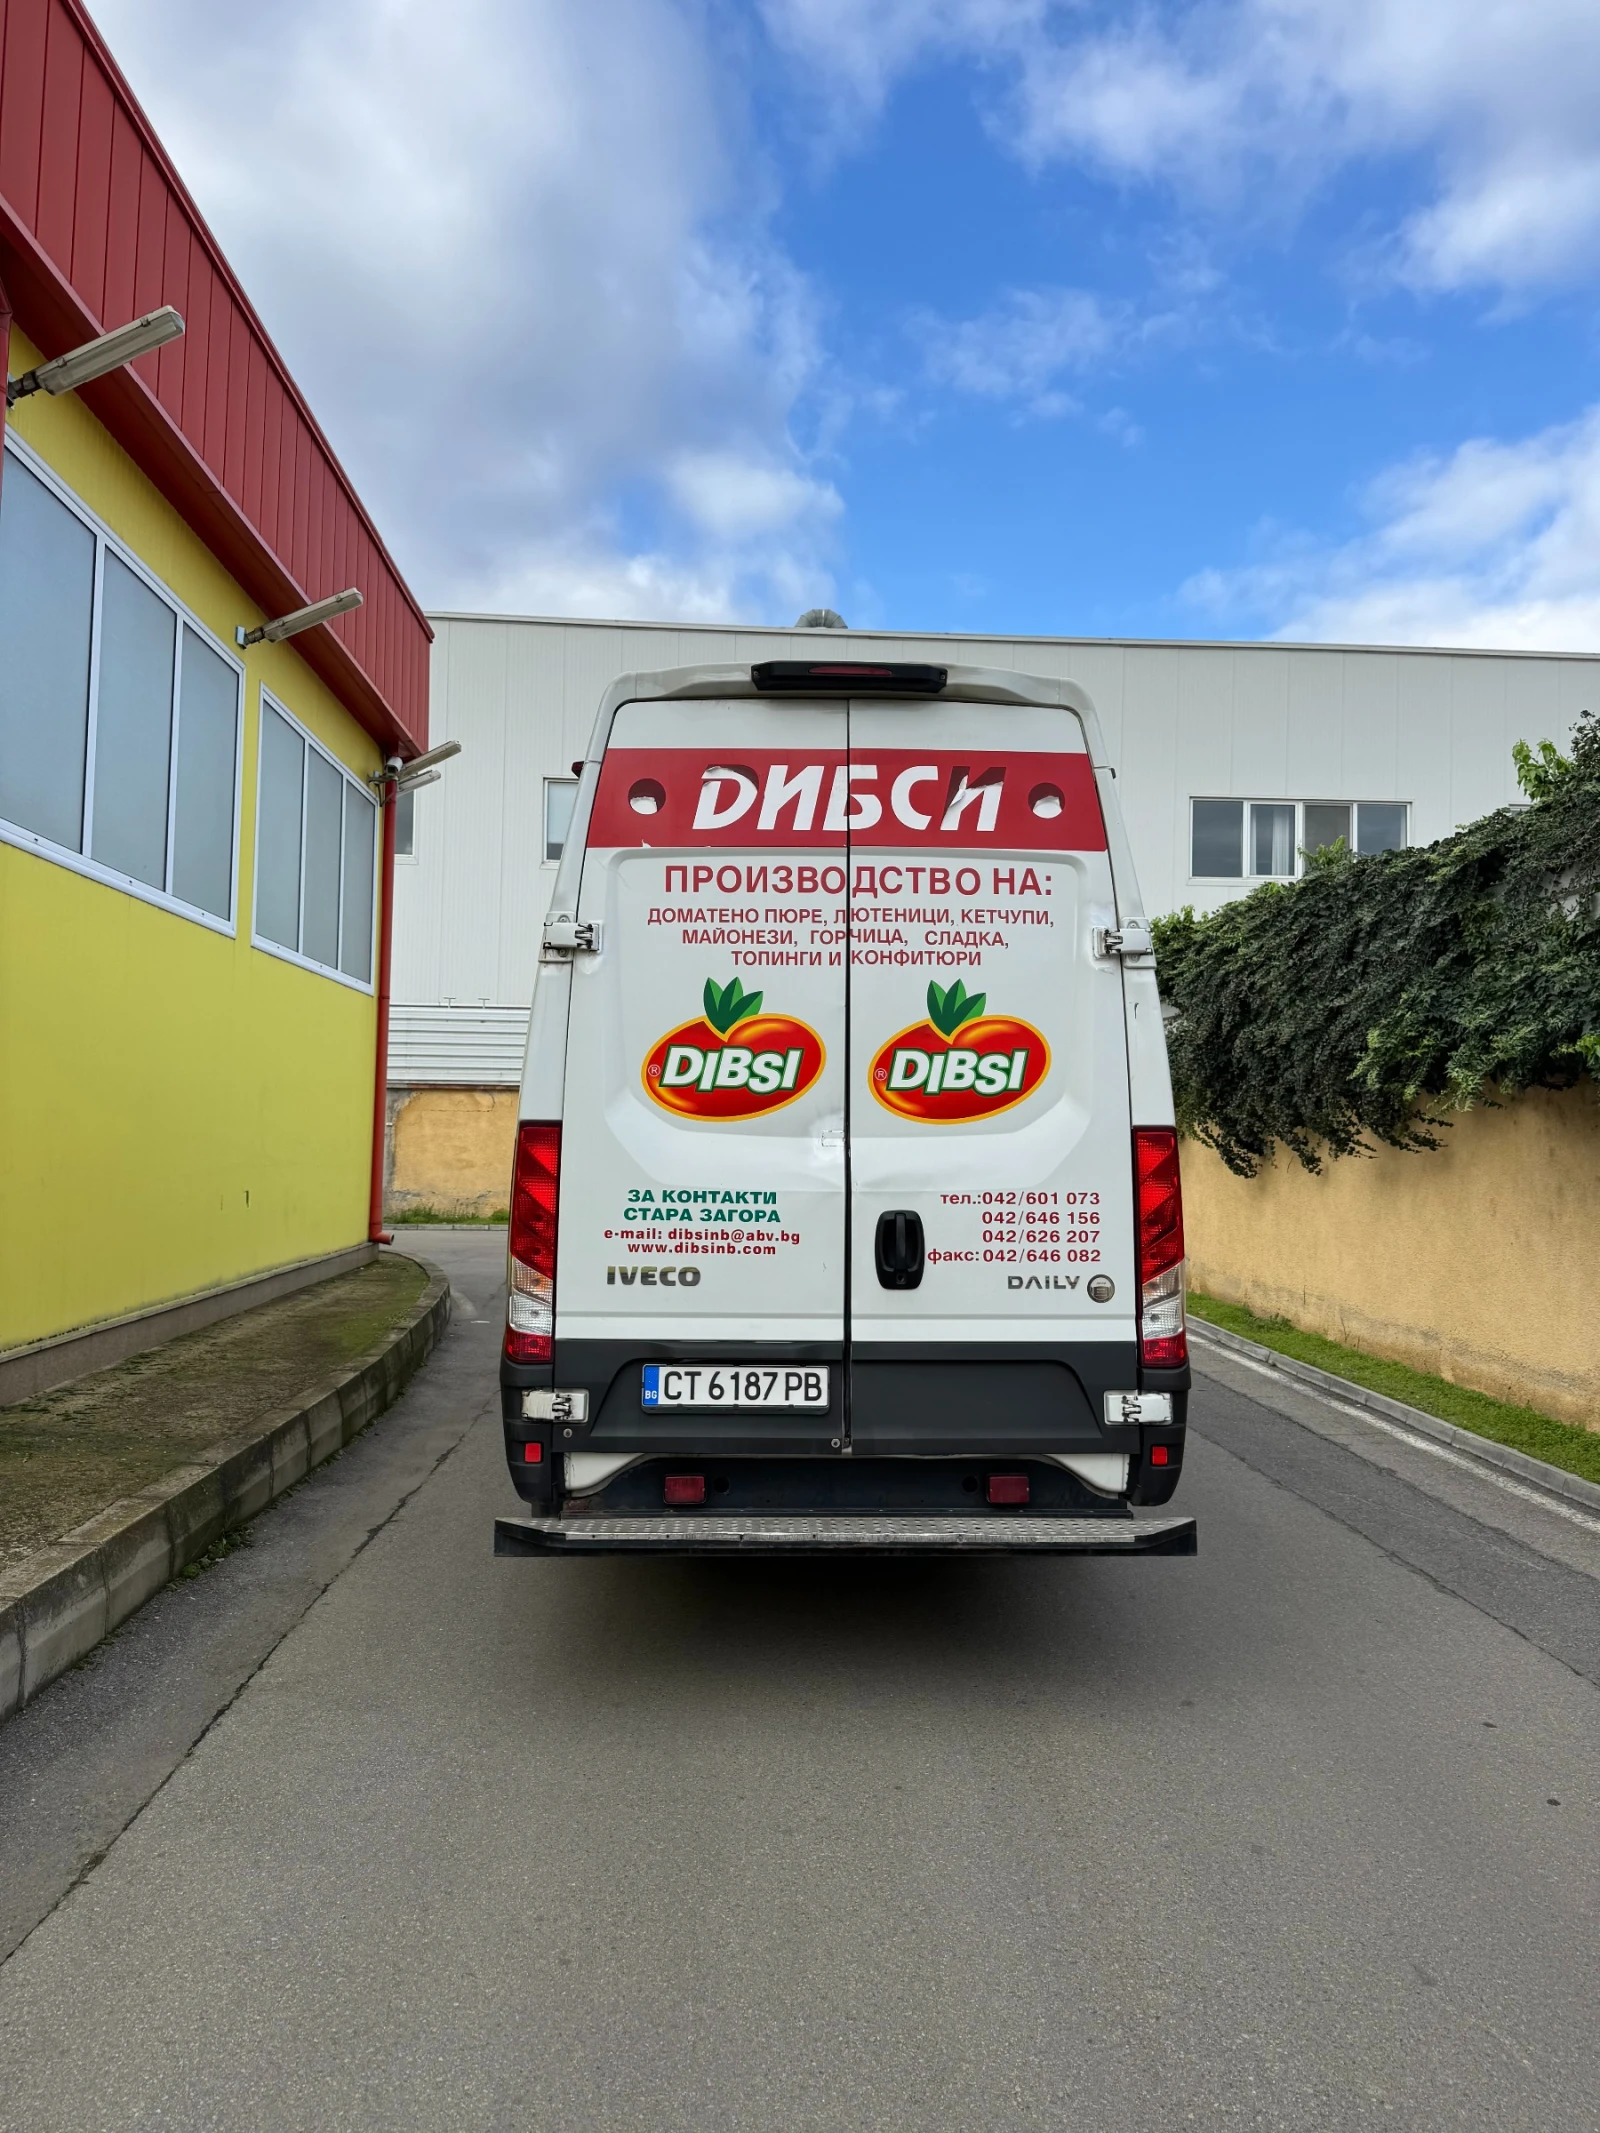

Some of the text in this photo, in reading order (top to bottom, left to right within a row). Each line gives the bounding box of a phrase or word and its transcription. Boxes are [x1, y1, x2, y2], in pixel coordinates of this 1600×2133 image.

[665, 865, 1052, 899] ПРОИЗВОДСТВО НА:
[648, 907, 1054, 927] ДОМАТЕНО ПЮРЕ, ЛЮТЕНИЦИ, КЕТЧУПИ,
[682, 928, 1009, 949] МАЙОНЕЗИ, ГОРЧИЦА, СЛАДКА,
[731, 950, 981, 966] ТОПИНГИ И КОНФИТЮРИ
[659, 1045, 804, 1095] DIBSI
[885, 1048, 1029, 1096] DIBSI
[627, 1189, 777, 1205] ЗА КОНТАКТИ
[1066, 1192, 1101, 1205] 073
[623, 1207, 781, 1223] СТАРА ЗАГОРА
[981, 1211, 1101, 1225] 042/646 156
[604, 1228, 800, 1244] e-mail: dibsinb@abv.bg
[982, 1229, 1101, 1244] 042/626 207
[627, 1242, 776, 1255] www.dibsinb.com
[1067, 1249, 1101, 1262] 082
[606, 1265, 702, 1287] IVECO
[1007, 1275, 1080, 1289] DAILY
[708, 1371, 778, 1401] 6187
[644, 1390, 658, 1399] BG
